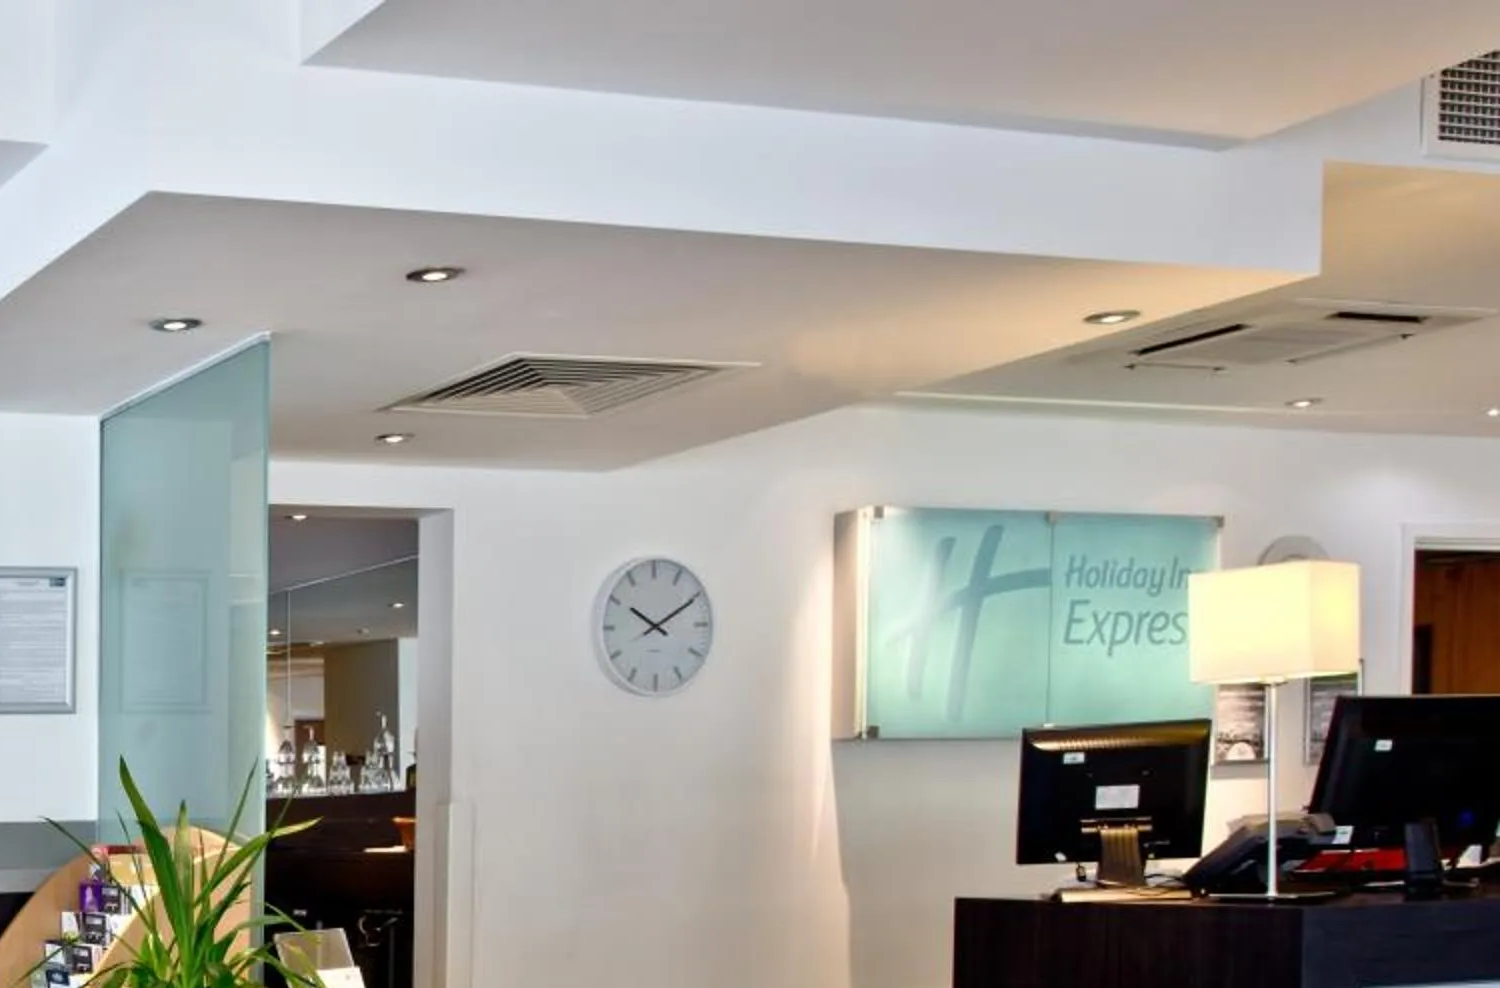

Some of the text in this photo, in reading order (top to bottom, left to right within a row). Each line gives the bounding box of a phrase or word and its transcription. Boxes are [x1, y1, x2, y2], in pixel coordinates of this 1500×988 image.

[1065, 554, 1191, 597] Holiday In
[1063, 598, 1188, 658] Expres
